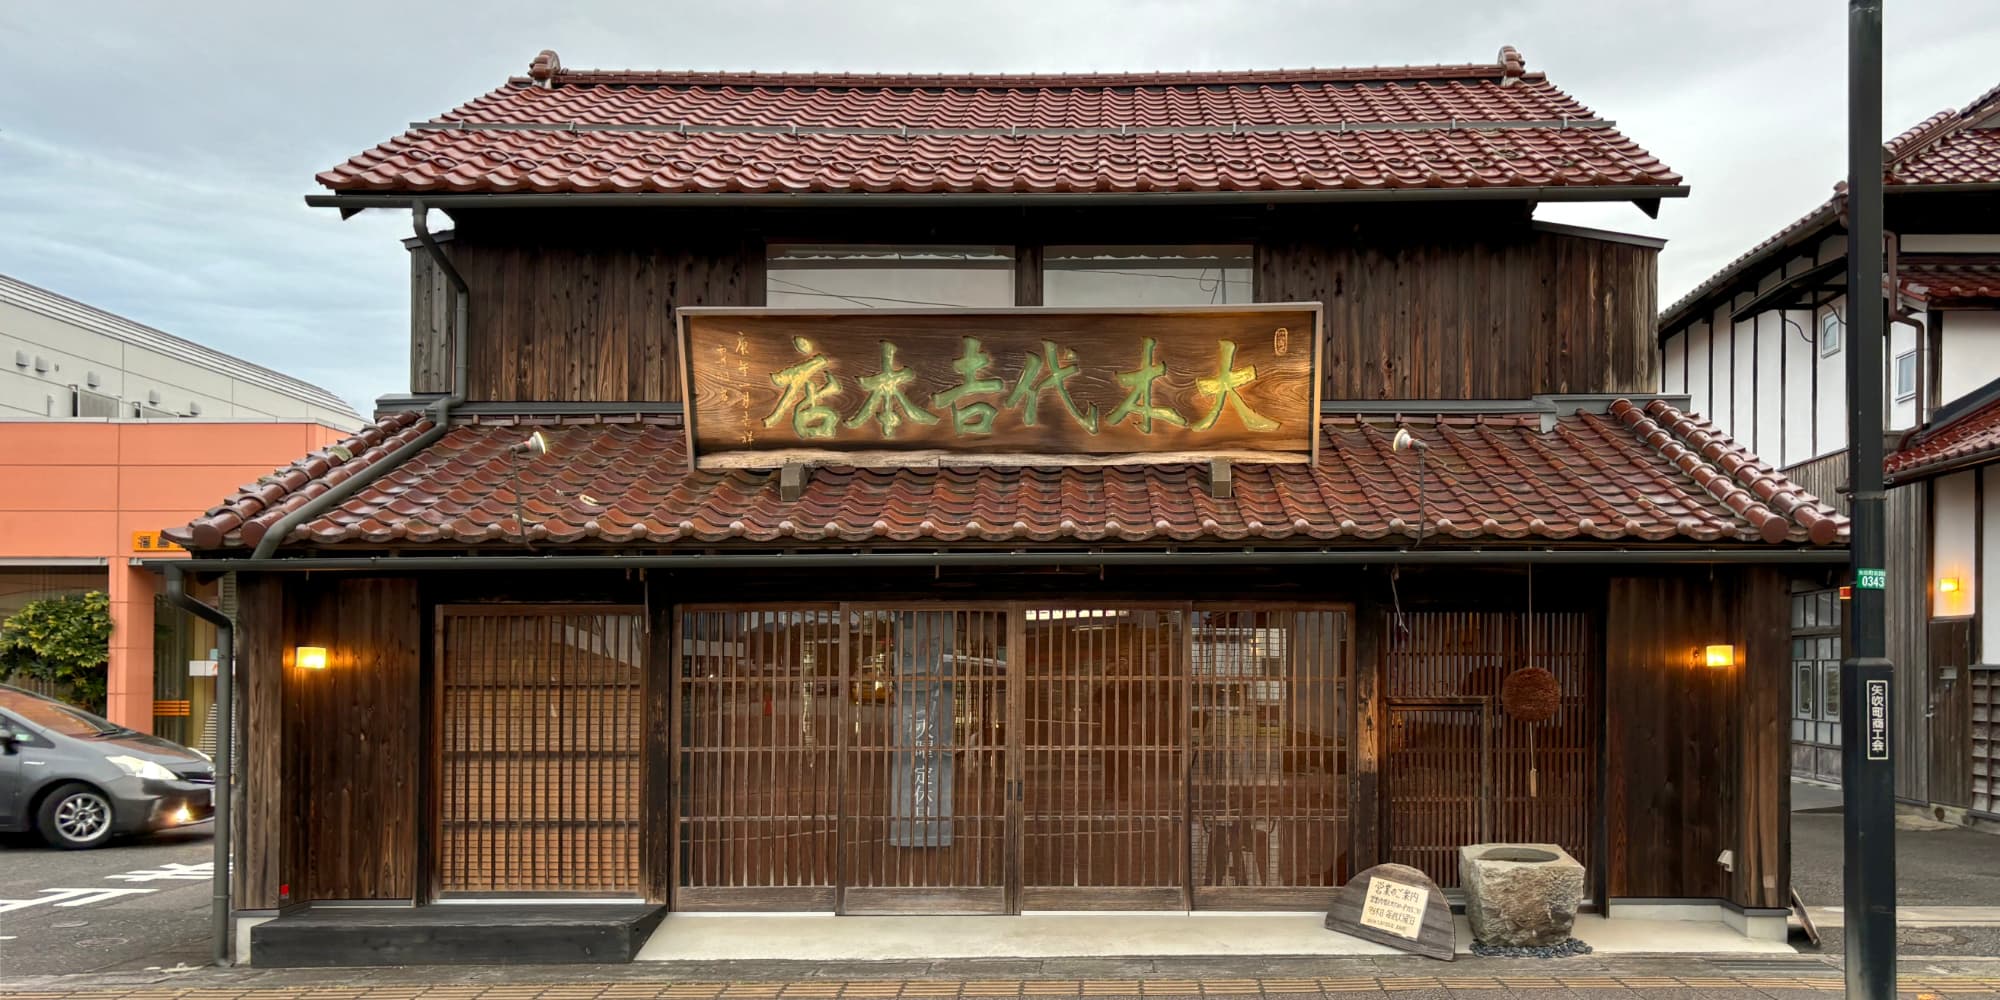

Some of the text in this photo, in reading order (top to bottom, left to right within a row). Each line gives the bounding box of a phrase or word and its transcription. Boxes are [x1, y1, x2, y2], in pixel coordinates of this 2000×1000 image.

[763, 335, 1281, 440] 大木代吉本店
[1862, 576, 1885, 588] 0343
[1872, 685, 1885, 752] 矢吹町商工会
